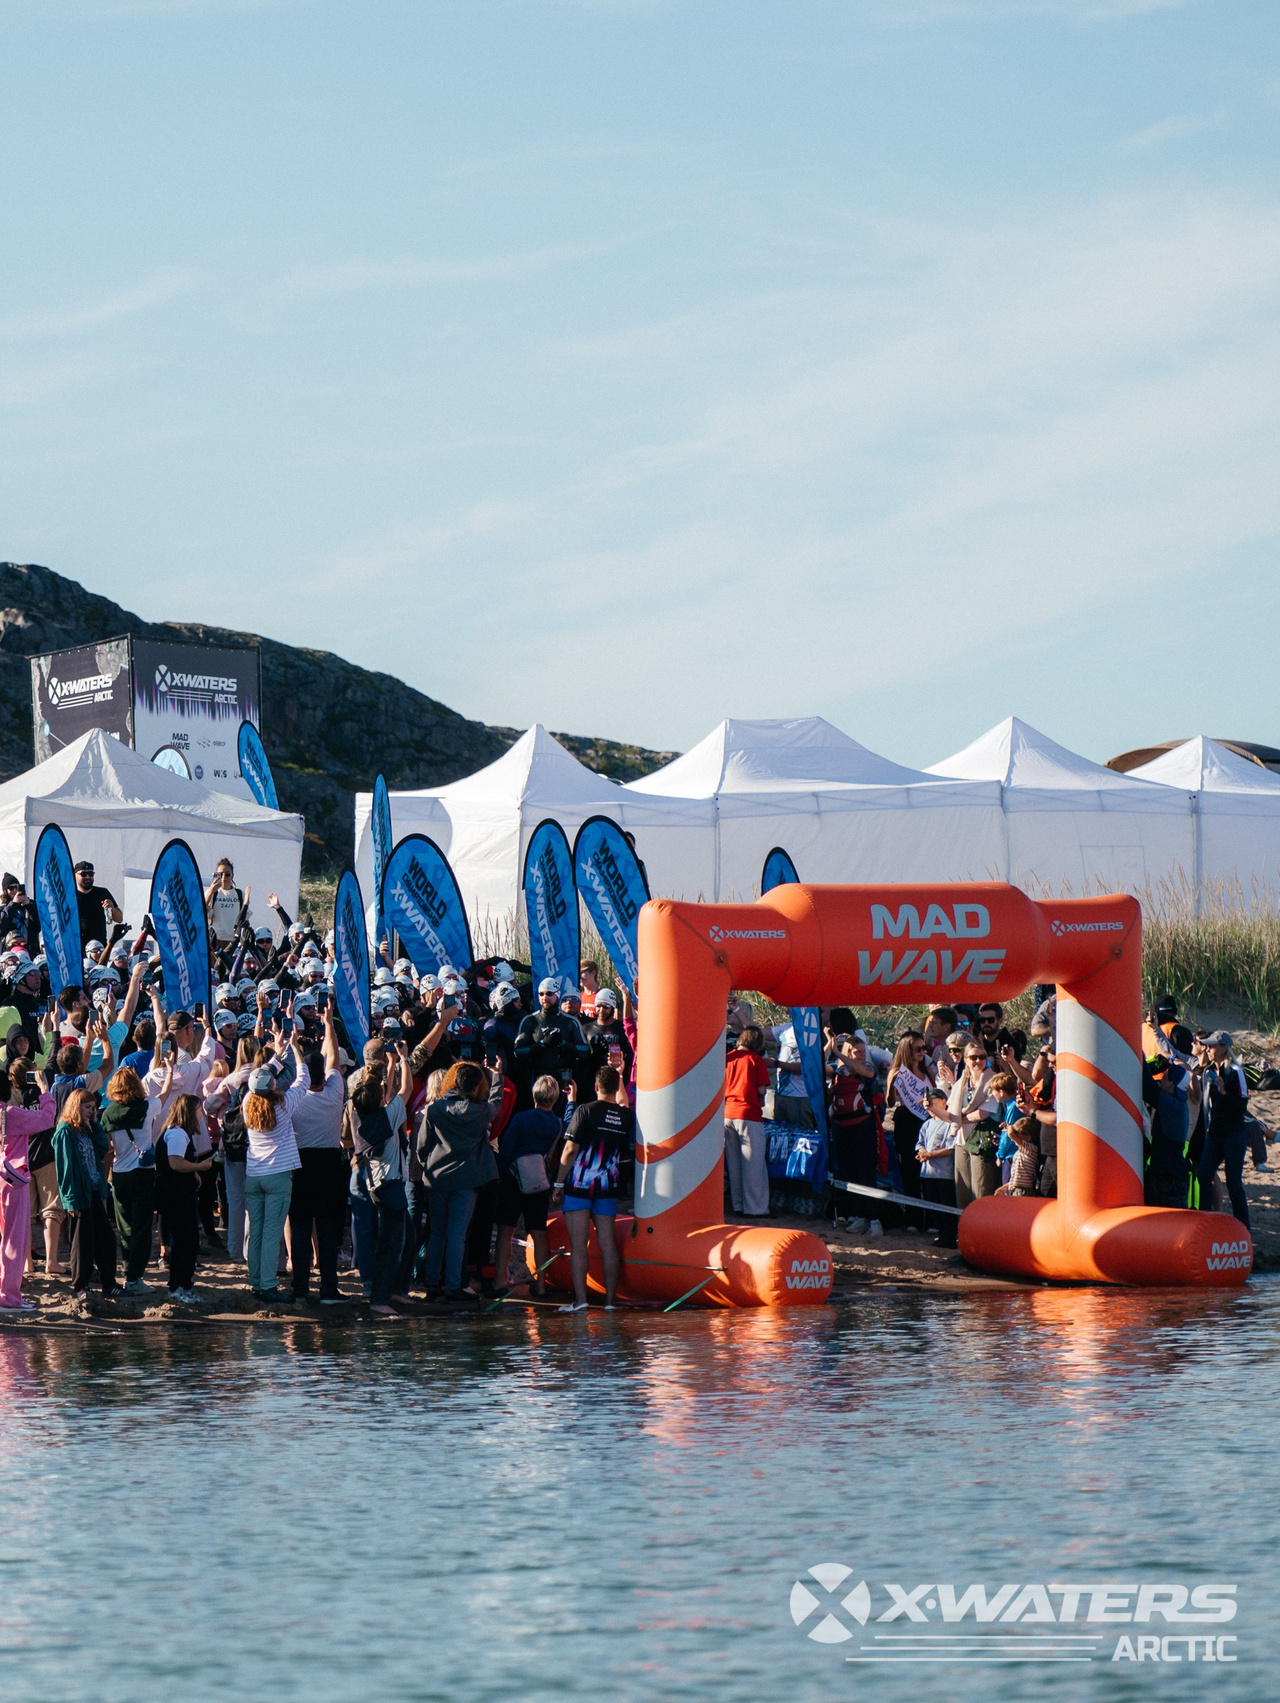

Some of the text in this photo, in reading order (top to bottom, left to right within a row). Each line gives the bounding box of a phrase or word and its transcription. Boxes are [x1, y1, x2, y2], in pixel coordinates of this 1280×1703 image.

[214, 693, 238, 704] ARCTIC
[172, 732, 189, 742] MAD
[49, 845, 71, 926] WORLD
[408, 854, 447, 921] WORLD
[544, 839, 566, 919] WORLD
[592, 851, 629, 928] CHAMPIONSHIP
[598, 837, 637, 921] WORLD
[173, 863, 197, 946] WORLD
[401, 872, 440, 929] CHAMPIONSHIP
[871, 903, 991, 939] MAD
[858, 949, 1007, 986] WAVE
[1206, 1255, 1251, 1270] WAVE
[1211, 1240, 1249, 1255] MAD
[785, 1275, 831, 1289] WAVE
[791, 1260, 829, 1273] MAD
